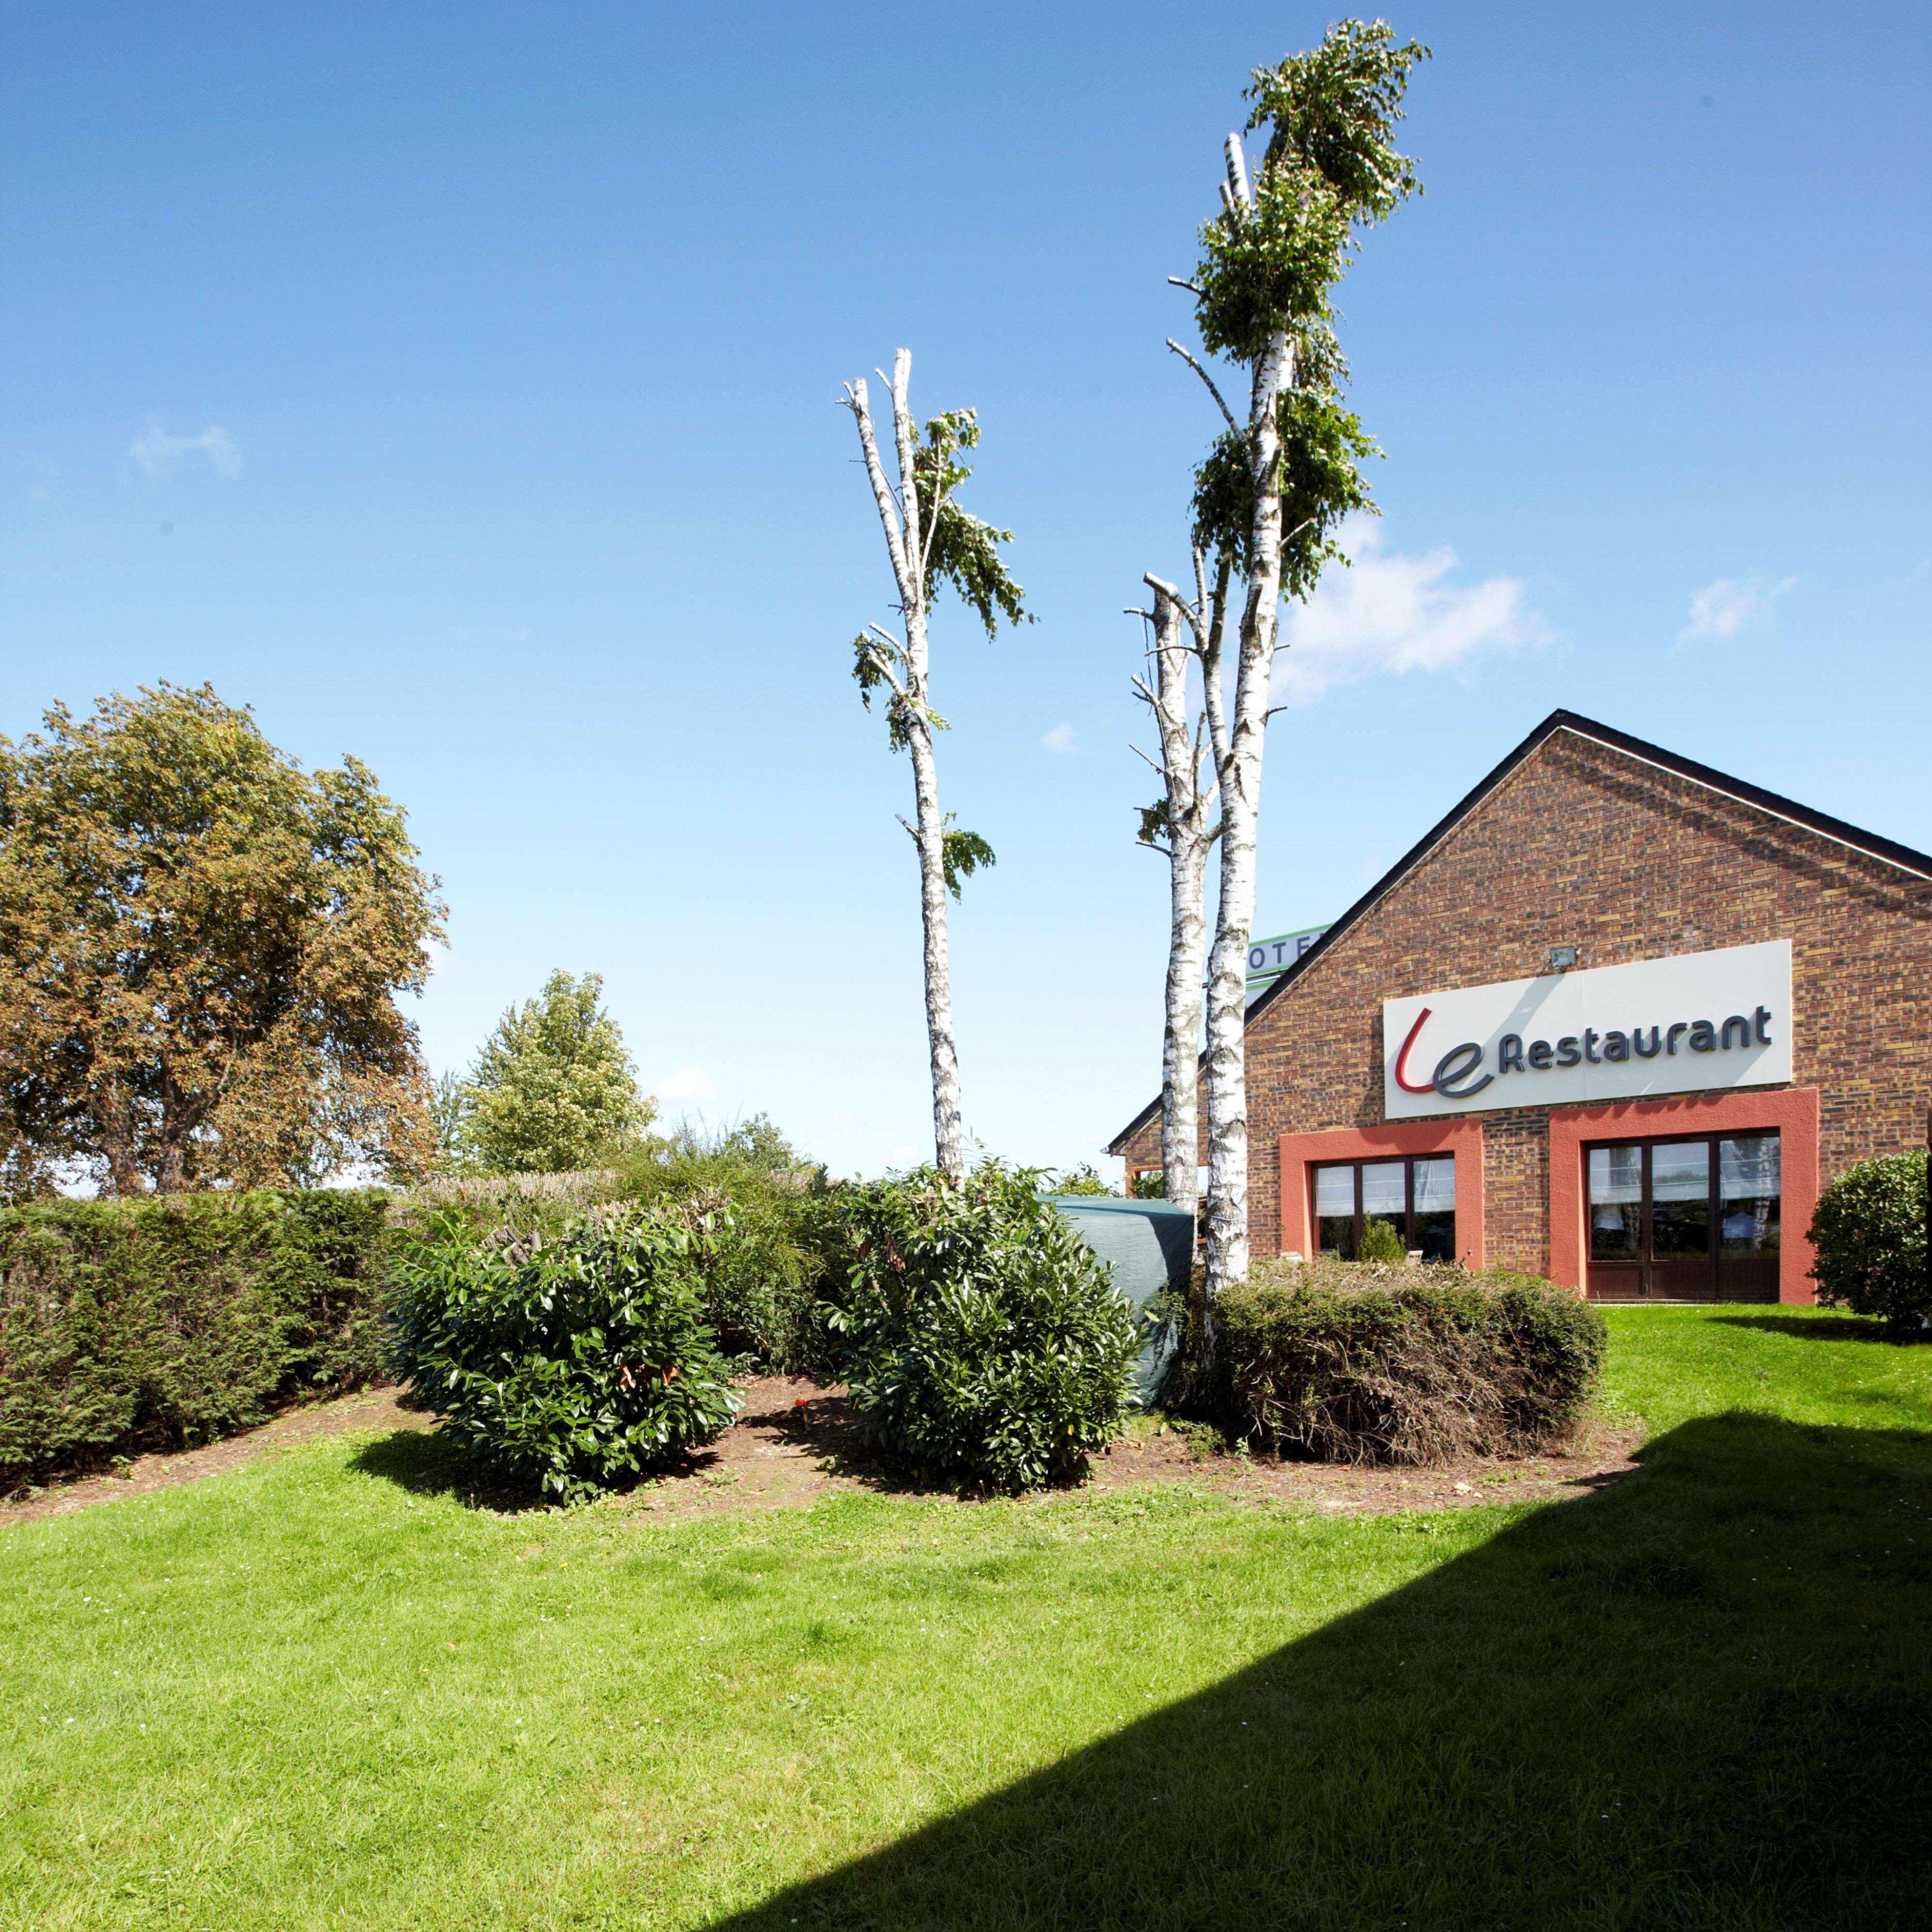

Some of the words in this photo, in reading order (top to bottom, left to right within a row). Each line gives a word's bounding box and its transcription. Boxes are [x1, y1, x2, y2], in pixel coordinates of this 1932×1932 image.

[1249, 933, 1325, 969] OTE
[1395, 1007, 1495, 1098] Le
[1499, 1005, 1772, 1074] Restaurant
